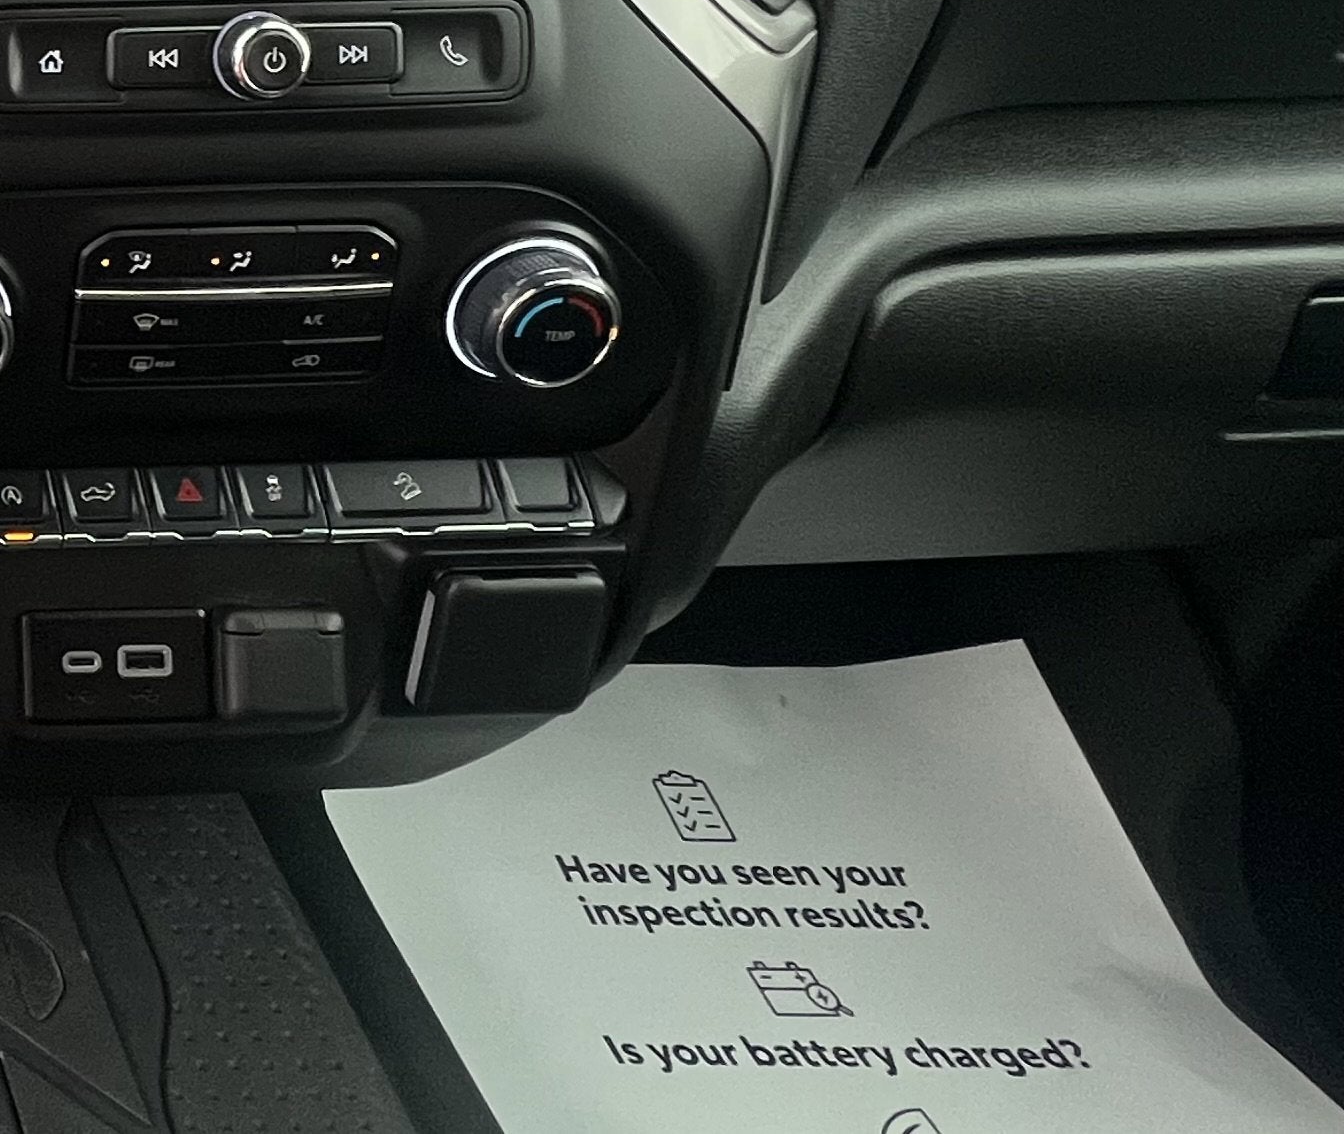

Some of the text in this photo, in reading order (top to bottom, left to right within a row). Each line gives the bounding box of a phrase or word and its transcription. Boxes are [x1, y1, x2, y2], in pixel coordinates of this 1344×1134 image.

[303, 314, 324, 326] A/C
[545, 330, 576, 342] TEMP
[555, 854, 907, 893] Have you seen your
[578, 896, 930, 933] inspection results?
[602, 1035, 1091, 1077] Is your battery charged?
